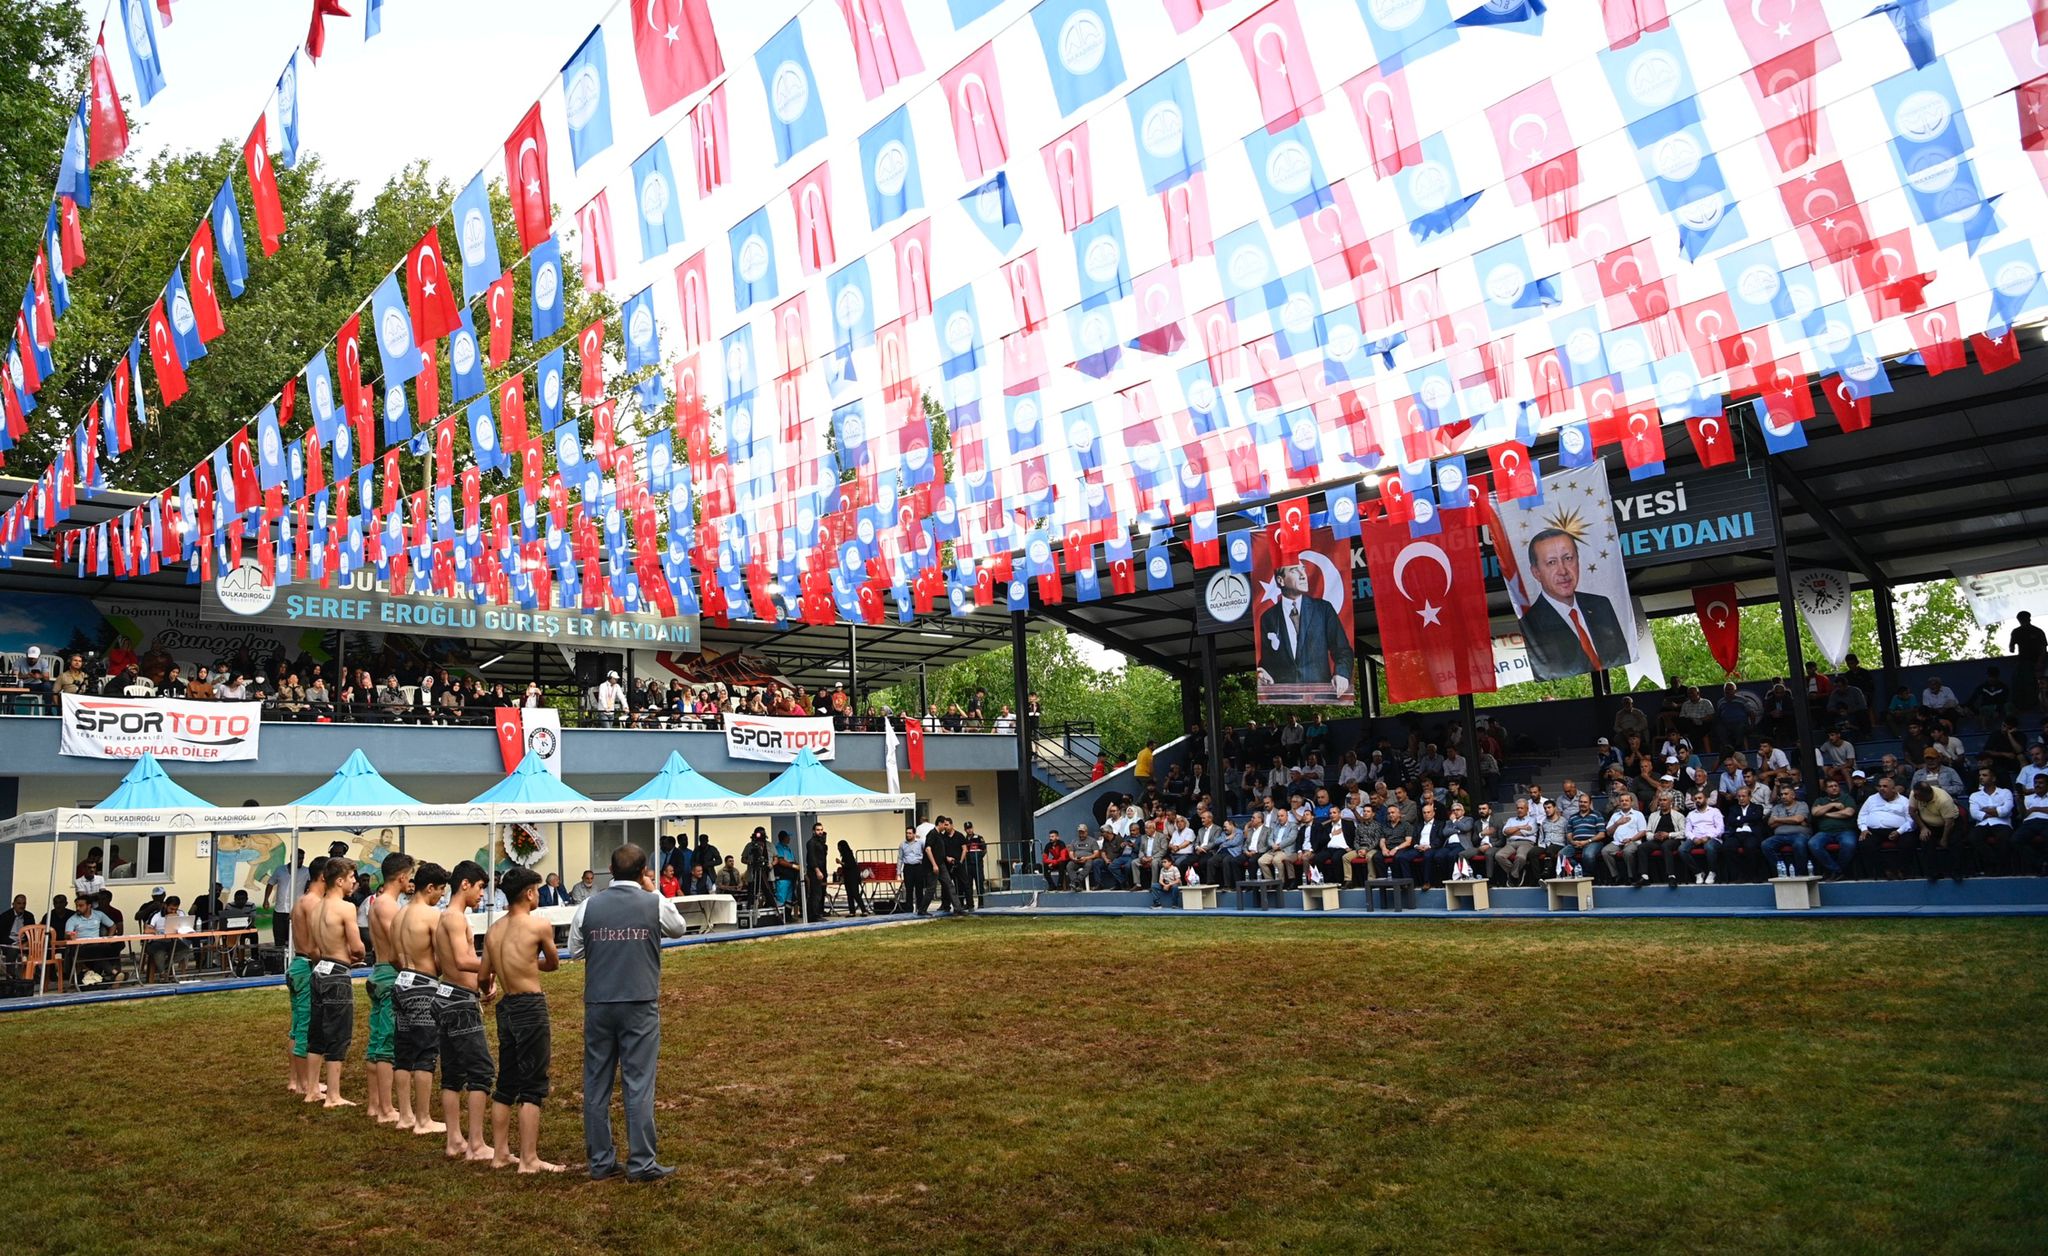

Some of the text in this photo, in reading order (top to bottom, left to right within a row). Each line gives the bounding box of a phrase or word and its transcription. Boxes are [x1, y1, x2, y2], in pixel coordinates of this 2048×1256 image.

[287, 595, 371, 620] ŞEREF
[380, 602, 476, 628] EROĞLU
[484, 606, 560, 637] GÜREŞ
[567, 617, 593, 637] ER
[166, 618, 213, 631] Mesire
[182, 745, 218, 758] DİLER
[104, 814, 161, 822] DULKADİROĞLU
[591, 927, 649, 941] TÜRKİYE
